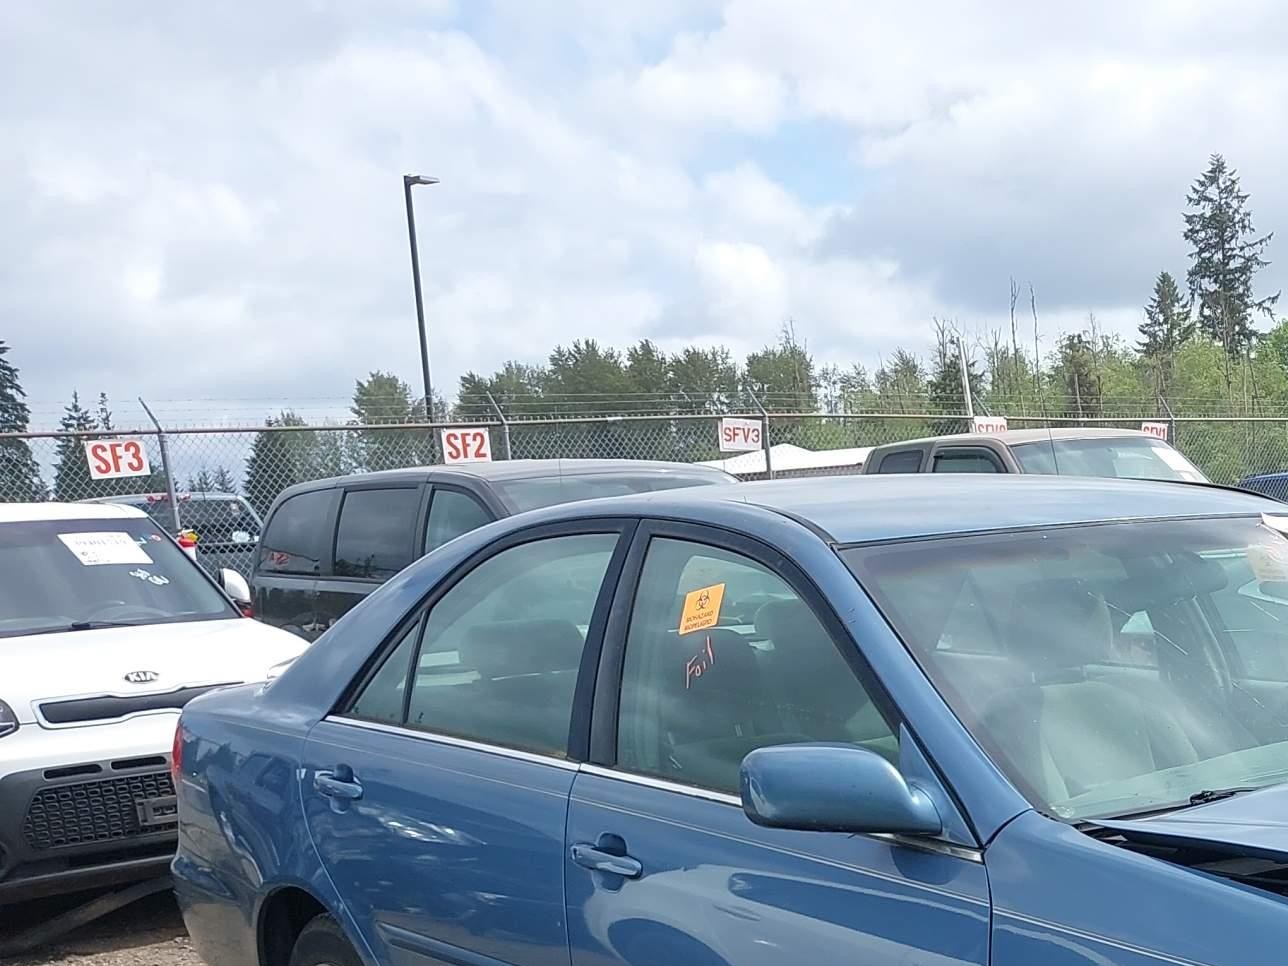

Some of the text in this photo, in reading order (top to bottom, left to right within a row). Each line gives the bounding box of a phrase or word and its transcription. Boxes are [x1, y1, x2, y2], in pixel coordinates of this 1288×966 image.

[446, 432, 487, 460] SF2
[723, 427, 760, 443] SFV3
[91, 441, 144, 474] SF3
[127, 671, 157, 682] KIA
